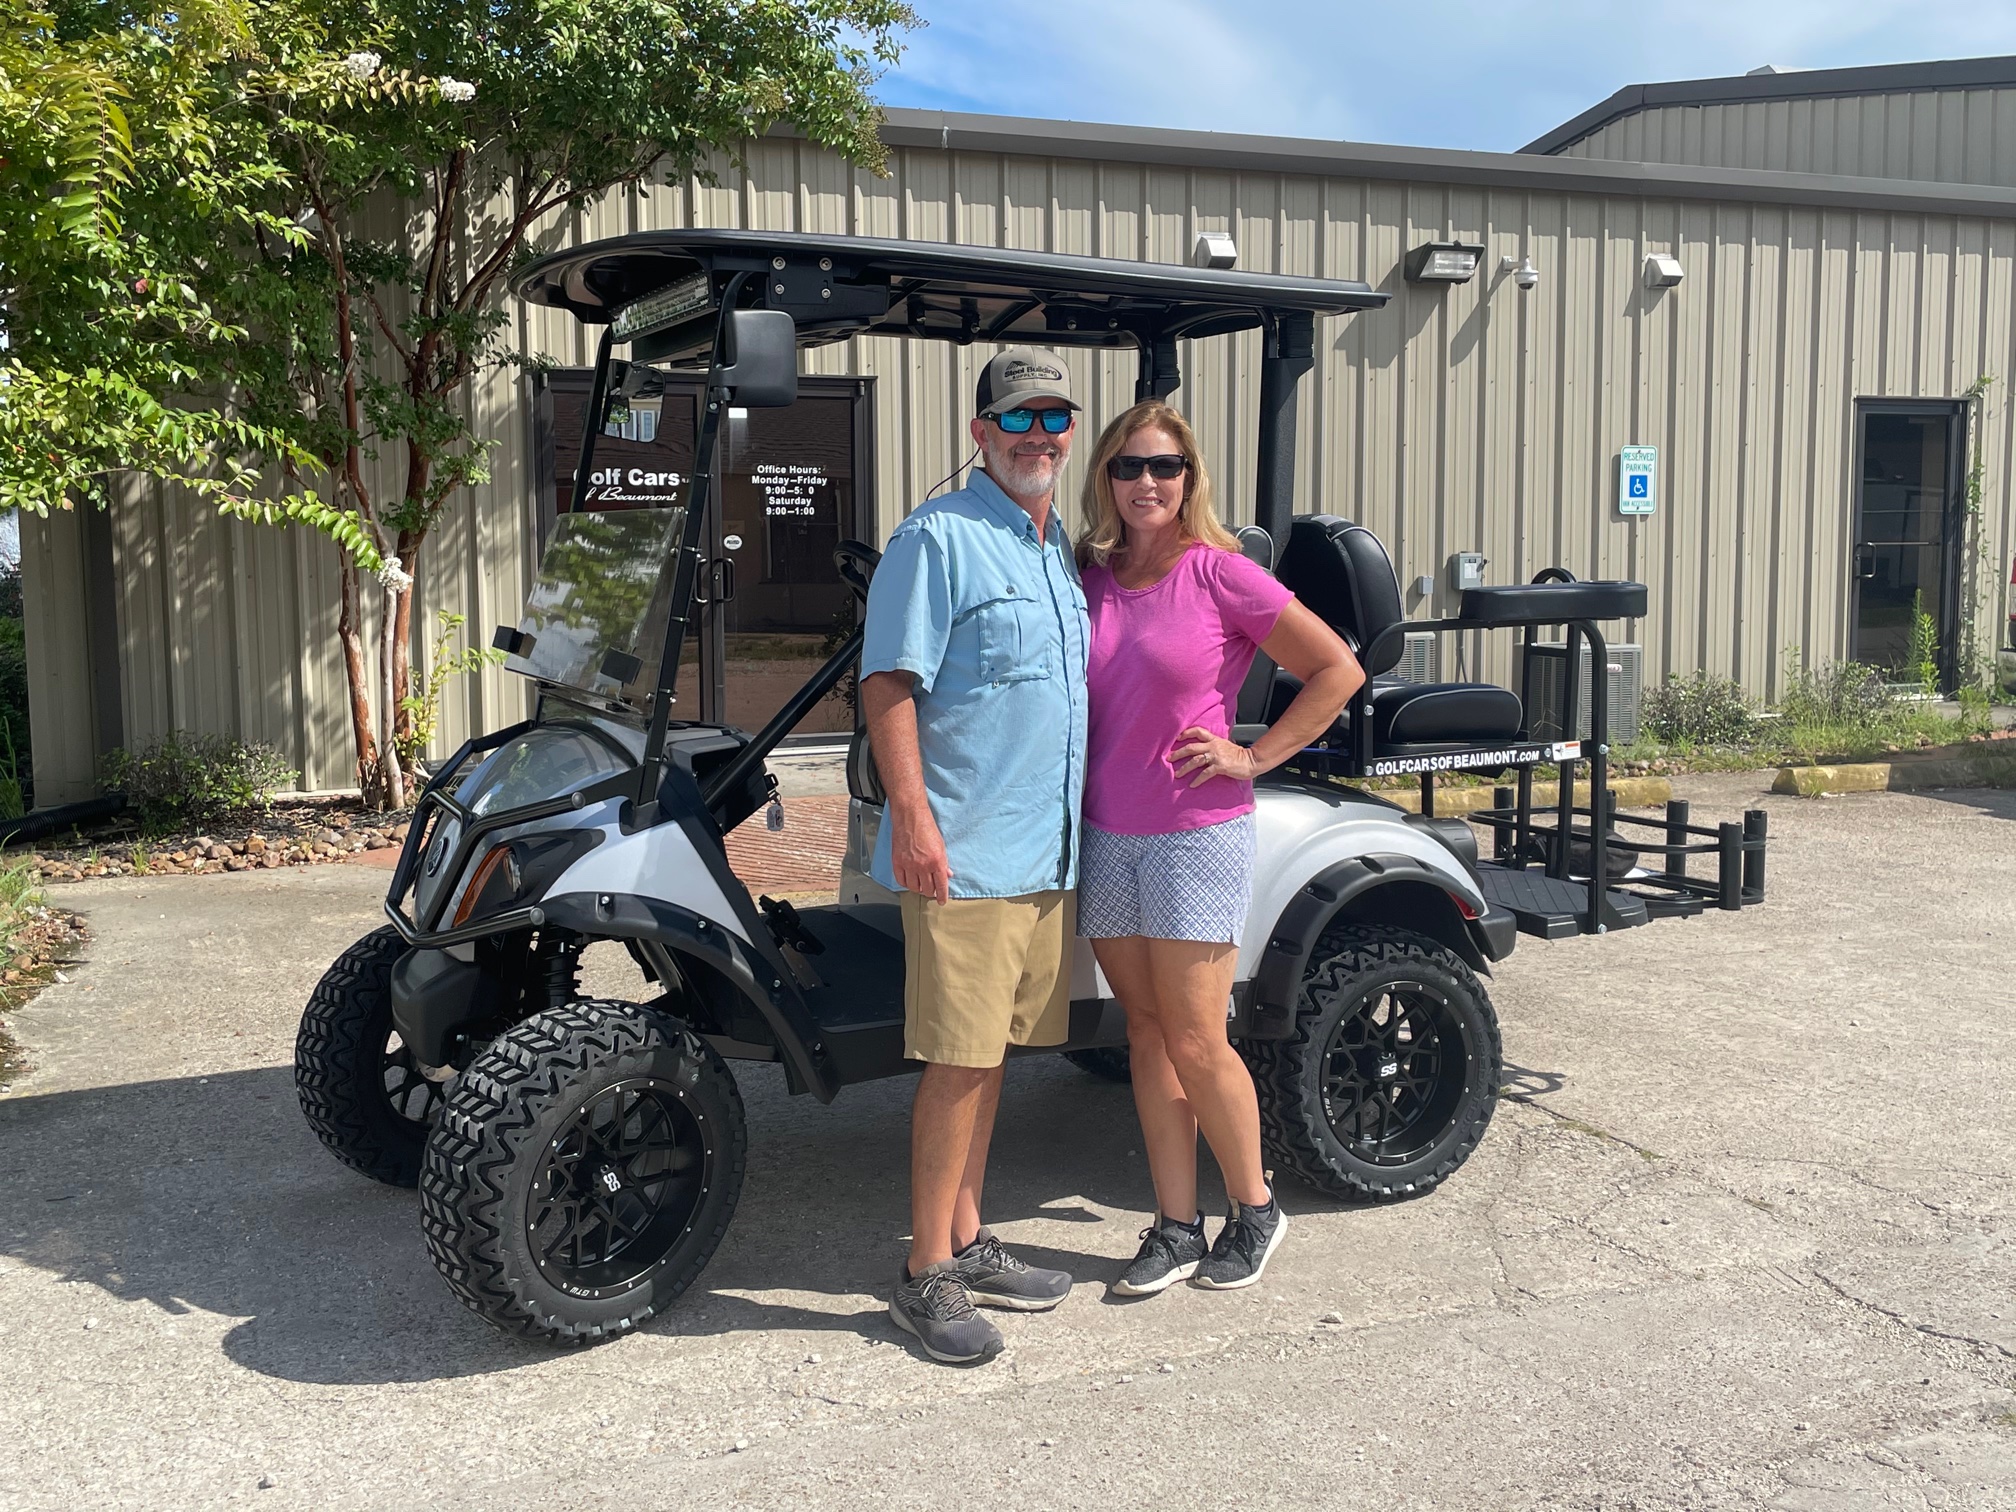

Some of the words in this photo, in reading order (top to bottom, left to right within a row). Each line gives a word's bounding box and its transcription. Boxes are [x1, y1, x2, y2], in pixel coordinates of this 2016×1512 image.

[1623, 453, 1654, 461] RESERVED
[757, 465, 787, 474] Office
[789, 465, 822, 474] Hours:
[1625, 464, 1652, 472] PARKING
[573, 467, 622, 486] olf
[627, 468, 681, 486] Cars
[598, 487, 678, 501] Beaumont
[768, 496, 812, 507] Saturday
